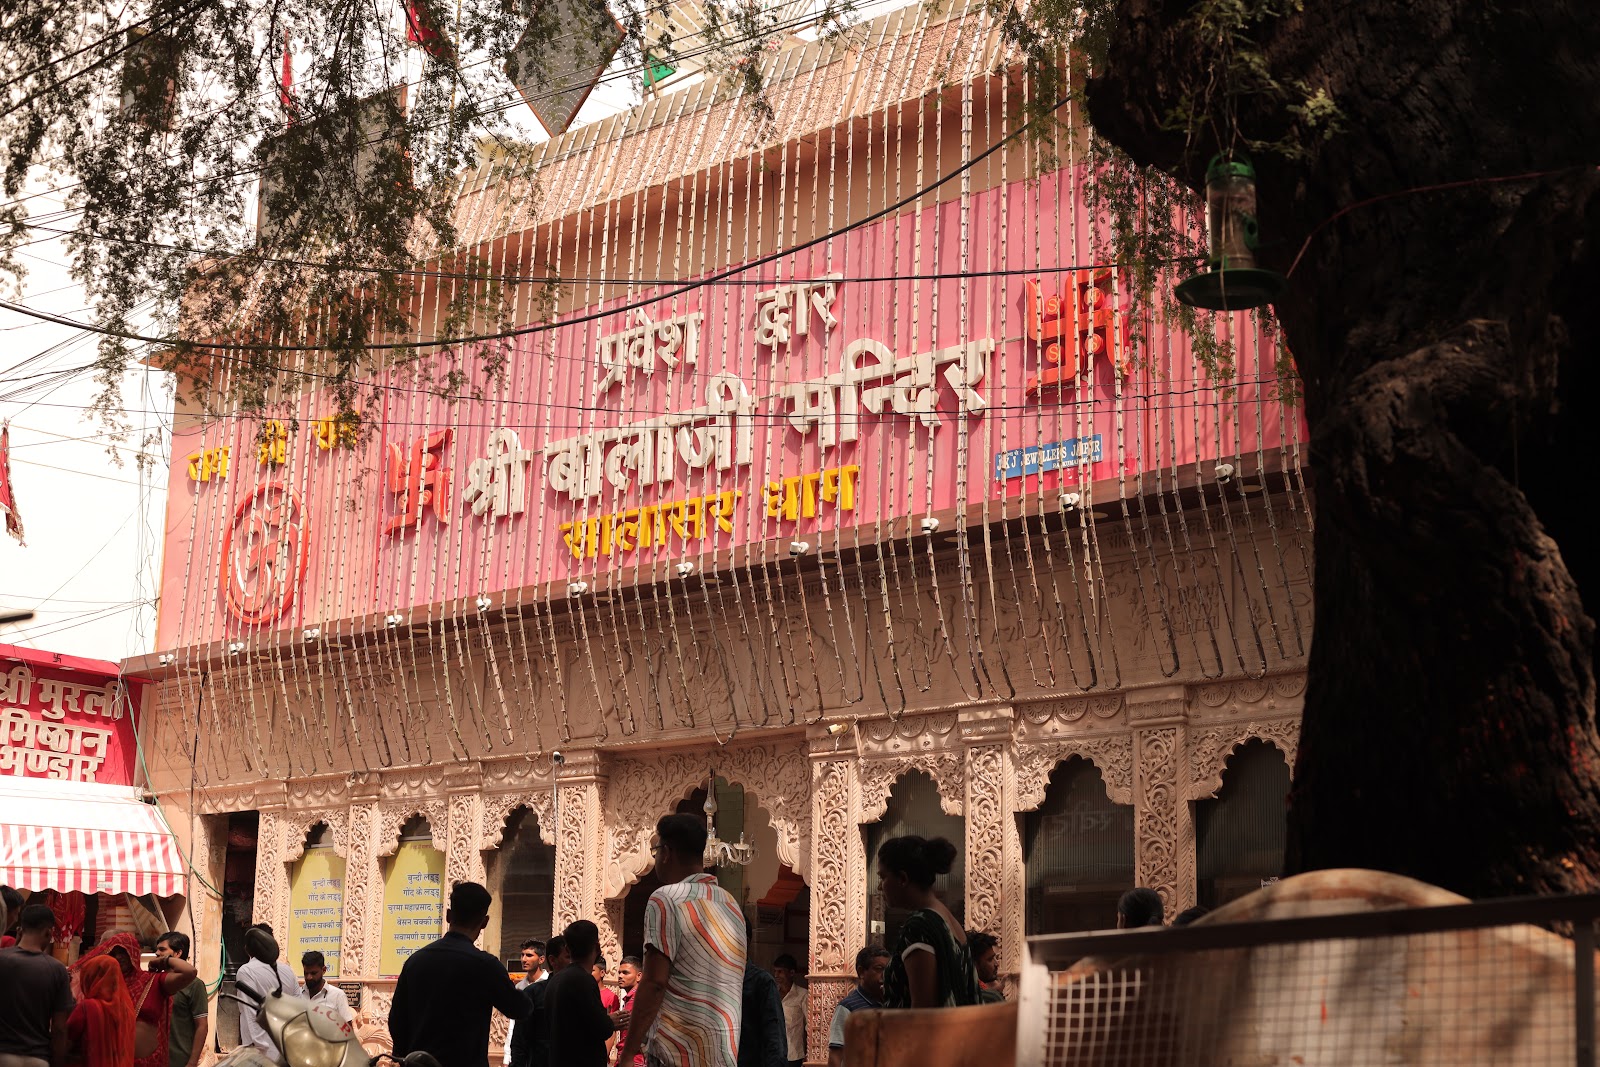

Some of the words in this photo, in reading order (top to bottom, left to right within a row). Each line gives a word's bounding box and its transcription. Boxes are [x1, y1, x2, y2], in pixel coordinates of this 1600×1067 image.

[597, 307, 704, 393] प्रवेश
[754, 272, 844, 348] द्वार
[462, 428, 531, 516] श्री
[547, 372, 760, 501] बालाजी
[779, 338, 996, 448] मन्दिर
[558, 489, 742, 560] सालासर
[761, 464, 860, 522] धाम
[37, 679, 127, 720] मुरली
[0, 745, 105, 782] भण्डार
